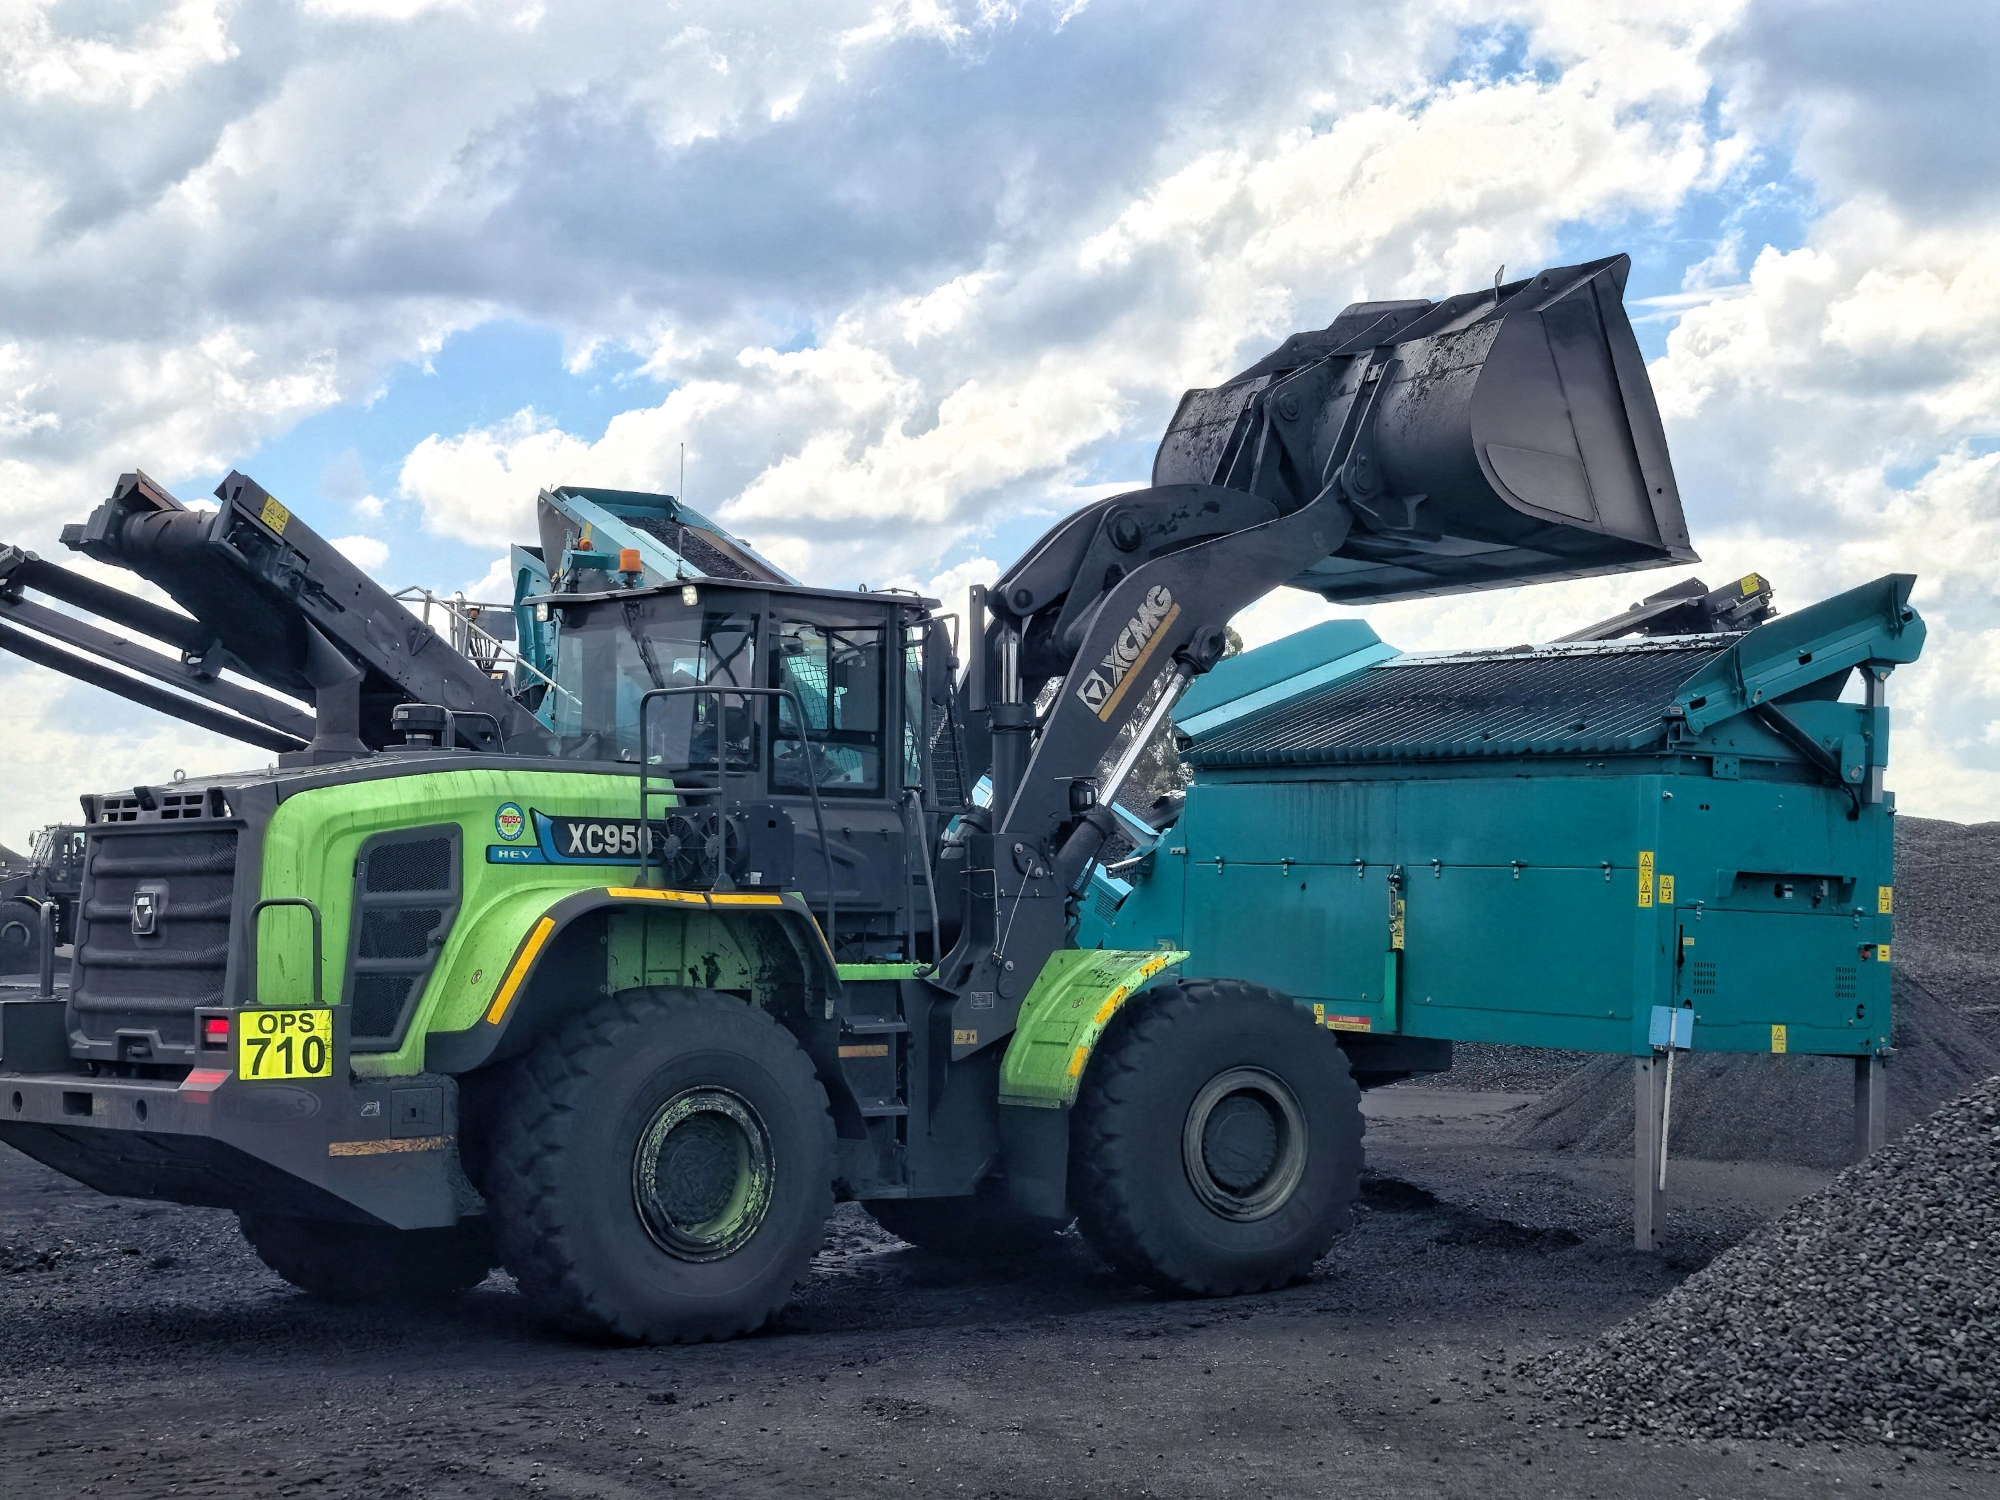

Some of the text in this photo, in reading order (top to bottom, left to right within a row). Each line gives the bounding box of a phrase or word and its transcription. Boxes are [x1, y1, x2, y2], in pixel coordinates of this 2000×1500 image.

[1100, 584, 1172, 688] XCMG
[498, 850, 532, 859] HEV
[257, 1012, 315, 1034] OPS
[246, 1035, 326, 1076] 710
